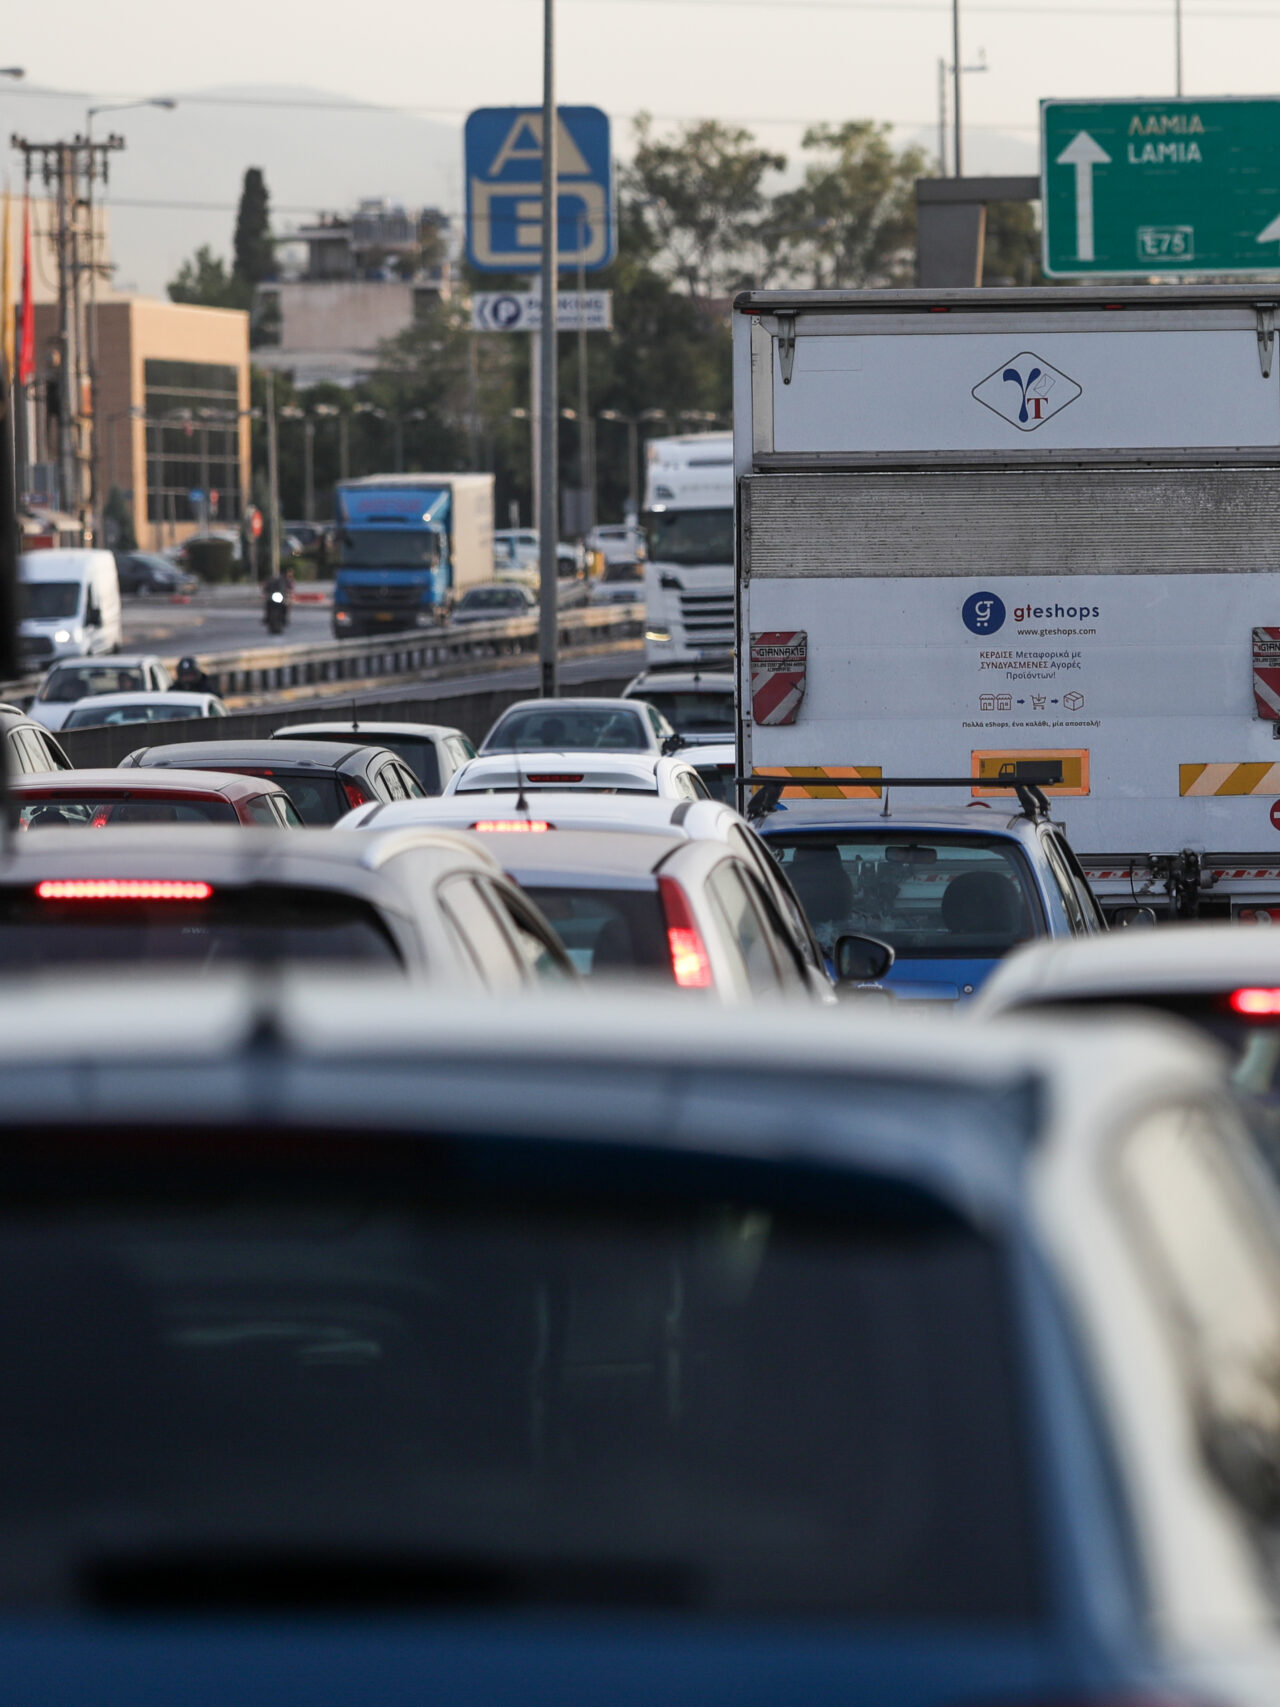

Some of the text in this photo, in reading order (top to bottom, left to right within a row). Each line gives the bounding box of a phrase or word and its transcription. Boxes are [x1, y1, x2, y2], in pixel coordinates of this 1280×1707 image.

[1128, 115, 1204, 136] ΛΑΜΙΑ
[1128, 142, 1202, 163] LAMIA
[1142, 233, 1185, 254] E75
[1013, 604, 1100, 622] gteshops
[1017, 627, 1097, 637] www.gteshops.com
[760, 648, 805, 656] GIANNAKIS
[979, 650, 1082, 660] ΚΕΡΔΙΣΕ Μεταφορικά με
[980, 660, 1081, 670] ΣΥΝΔΥΑΣΜΕΝΕΣ Αγορές
